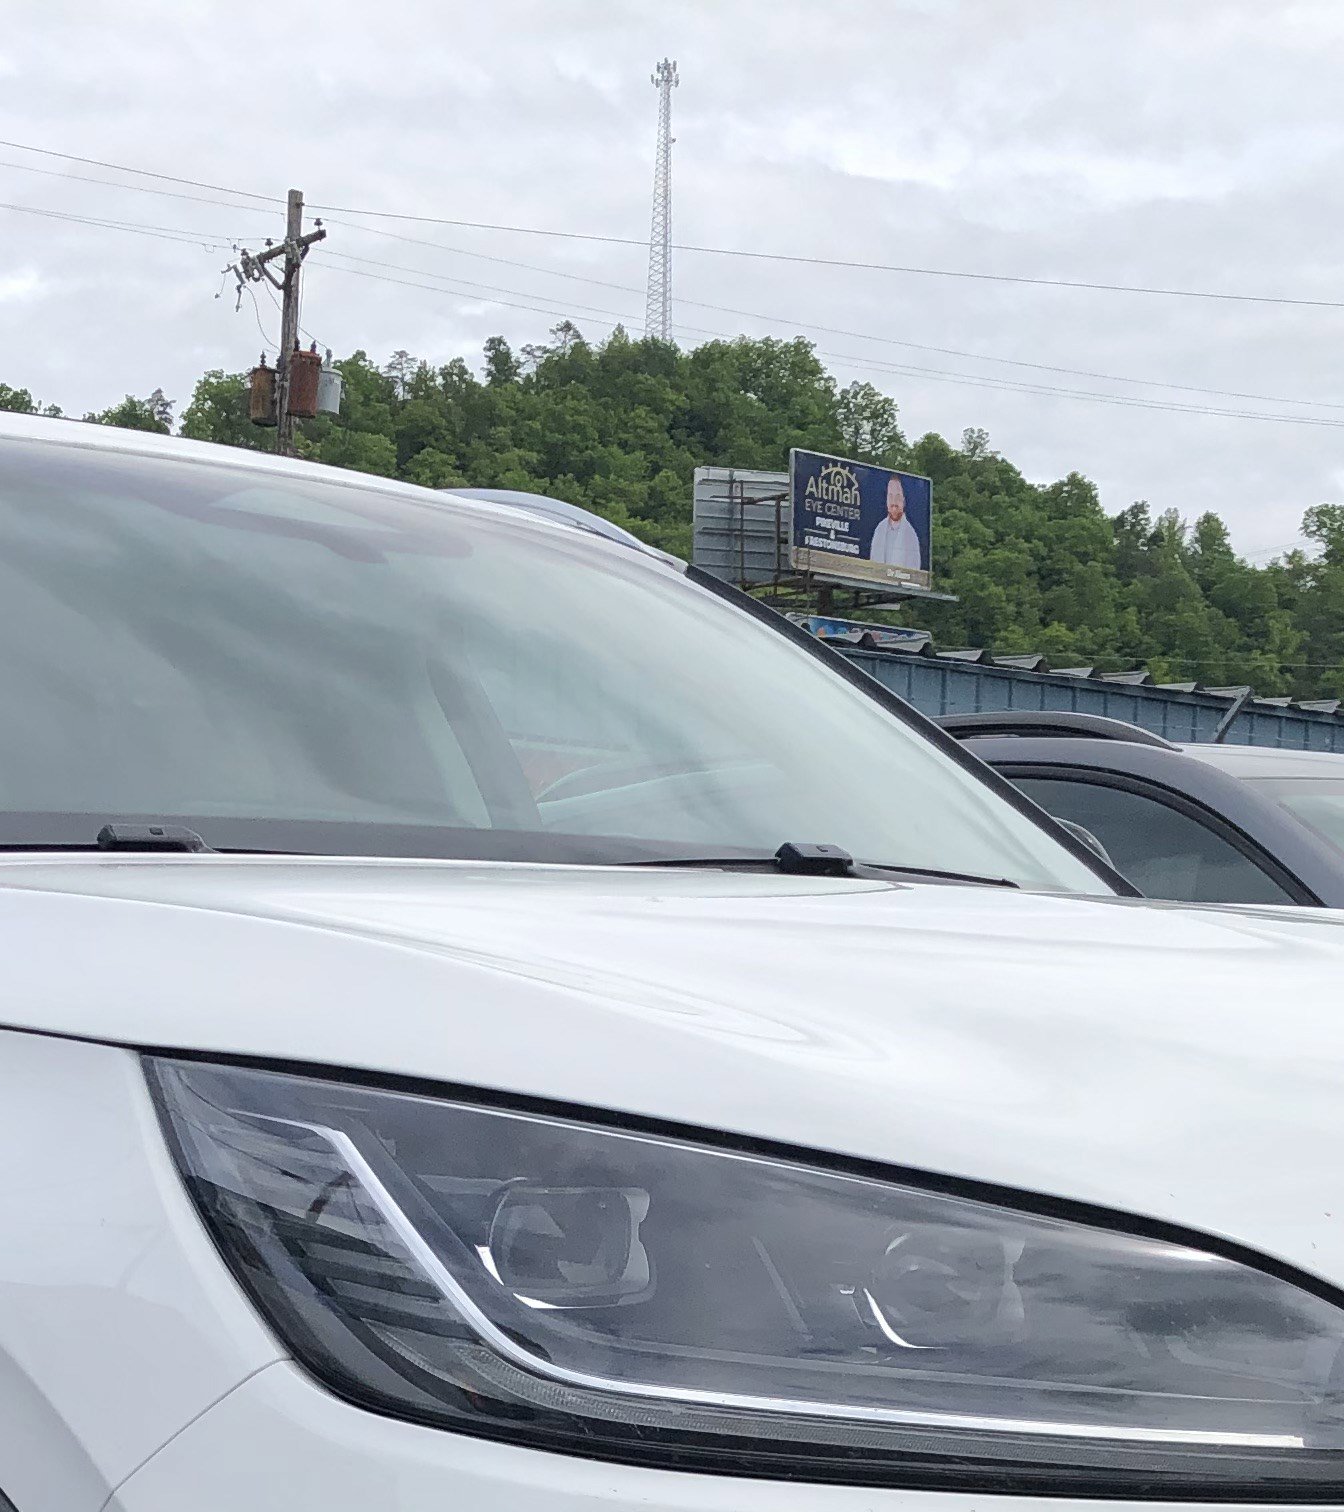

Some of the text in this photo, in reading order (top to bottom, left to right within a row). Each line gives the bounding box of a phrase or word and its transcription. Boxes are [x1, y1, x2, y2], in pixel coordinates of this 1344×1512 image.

[805, 475, 861, 506] Altman
[805, 498, 861, 520] EYE CENTER
